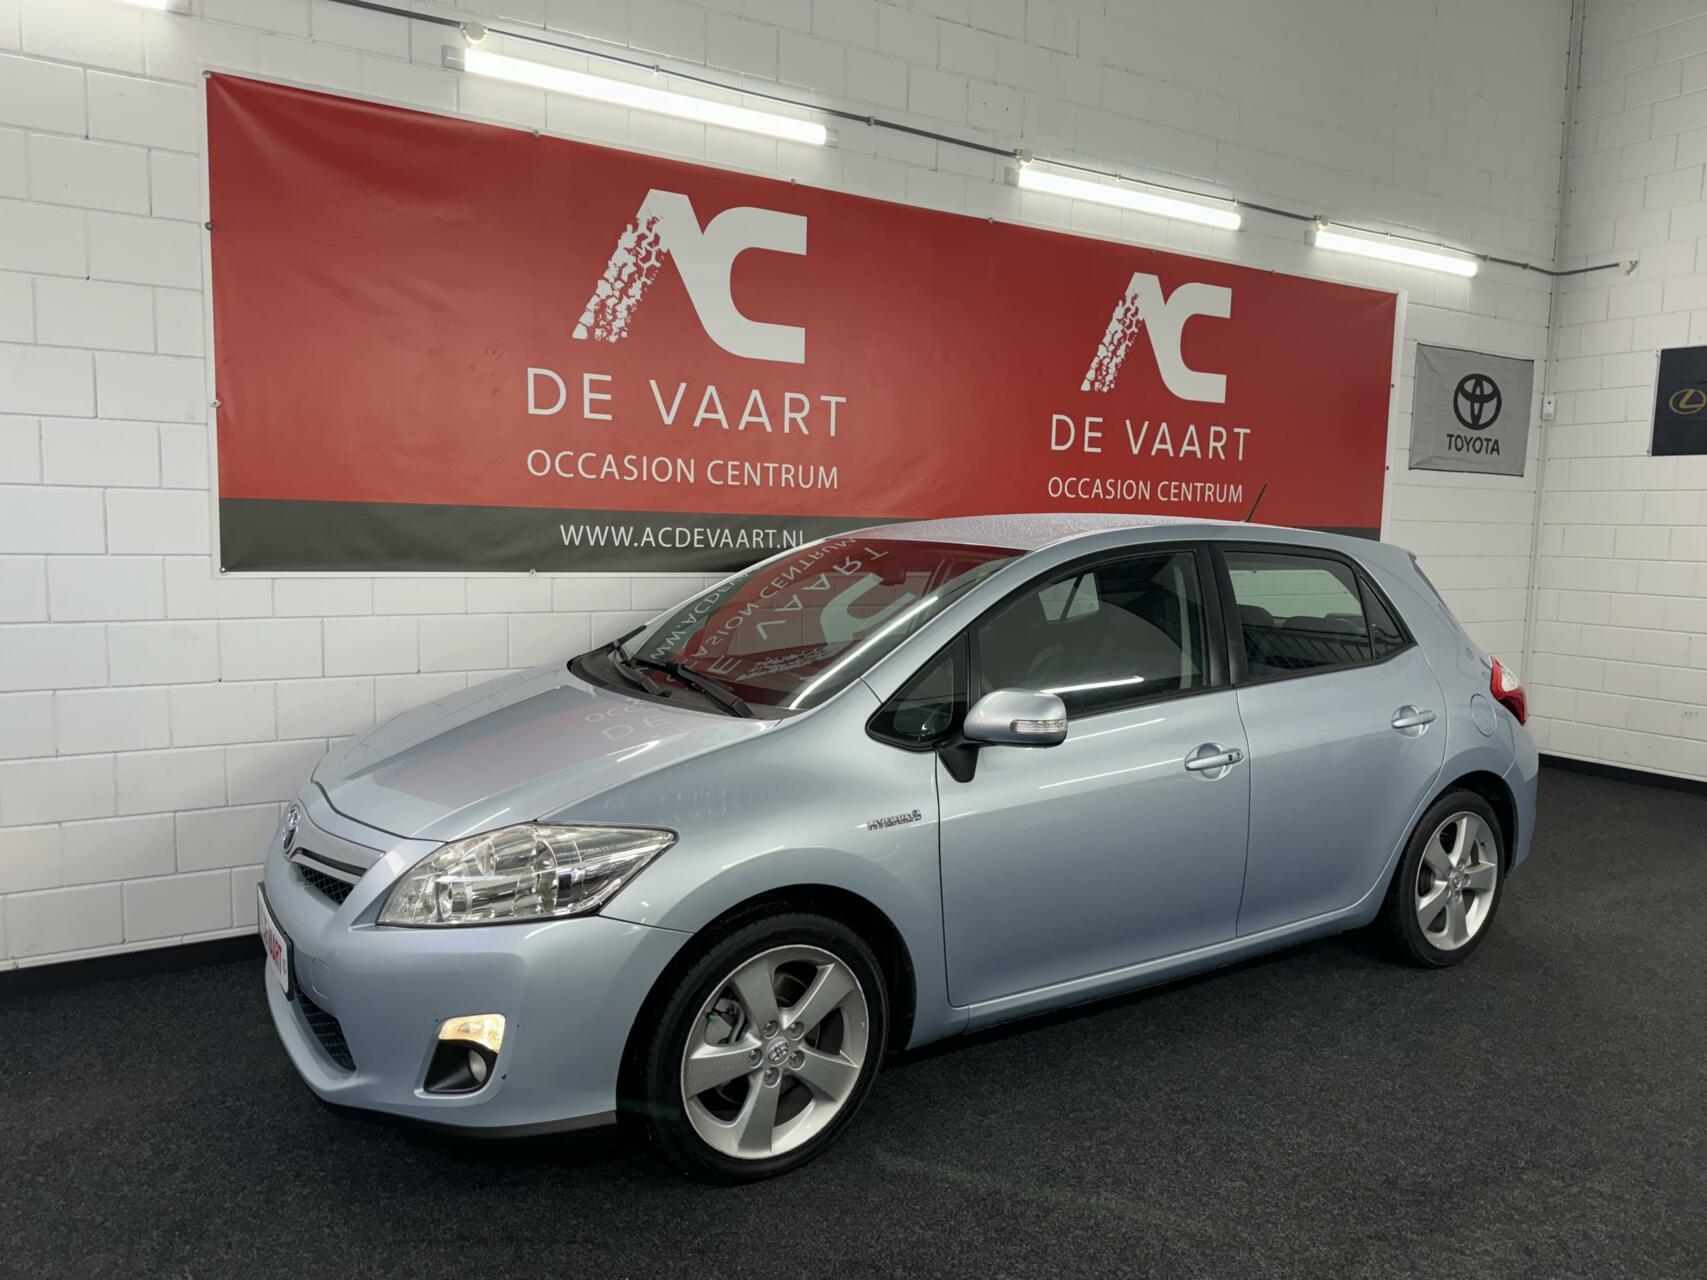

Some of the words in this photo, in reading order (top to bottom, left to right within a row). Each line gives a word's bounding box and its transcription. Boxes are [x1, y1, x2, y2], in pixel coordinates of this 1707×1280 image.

[571, 188, 807, 364] AC
[1080, 272, 1232, 404] AC
[527, 367, 612, 421] DE
[649, 379, 847, 437] VAART
[1050, 414, 1104, 452] DE
[1125, 419, 1251, 461] VAART
[1446, 433, 1500, 456] TOYOTA
[527, 449, 695, 484] OCCASION
[707, 459, 838, 489] CENTRUM
[1048, 476, 1151, 500] OCCASION
[1157, 481, 1243, 503] CENTRUM
